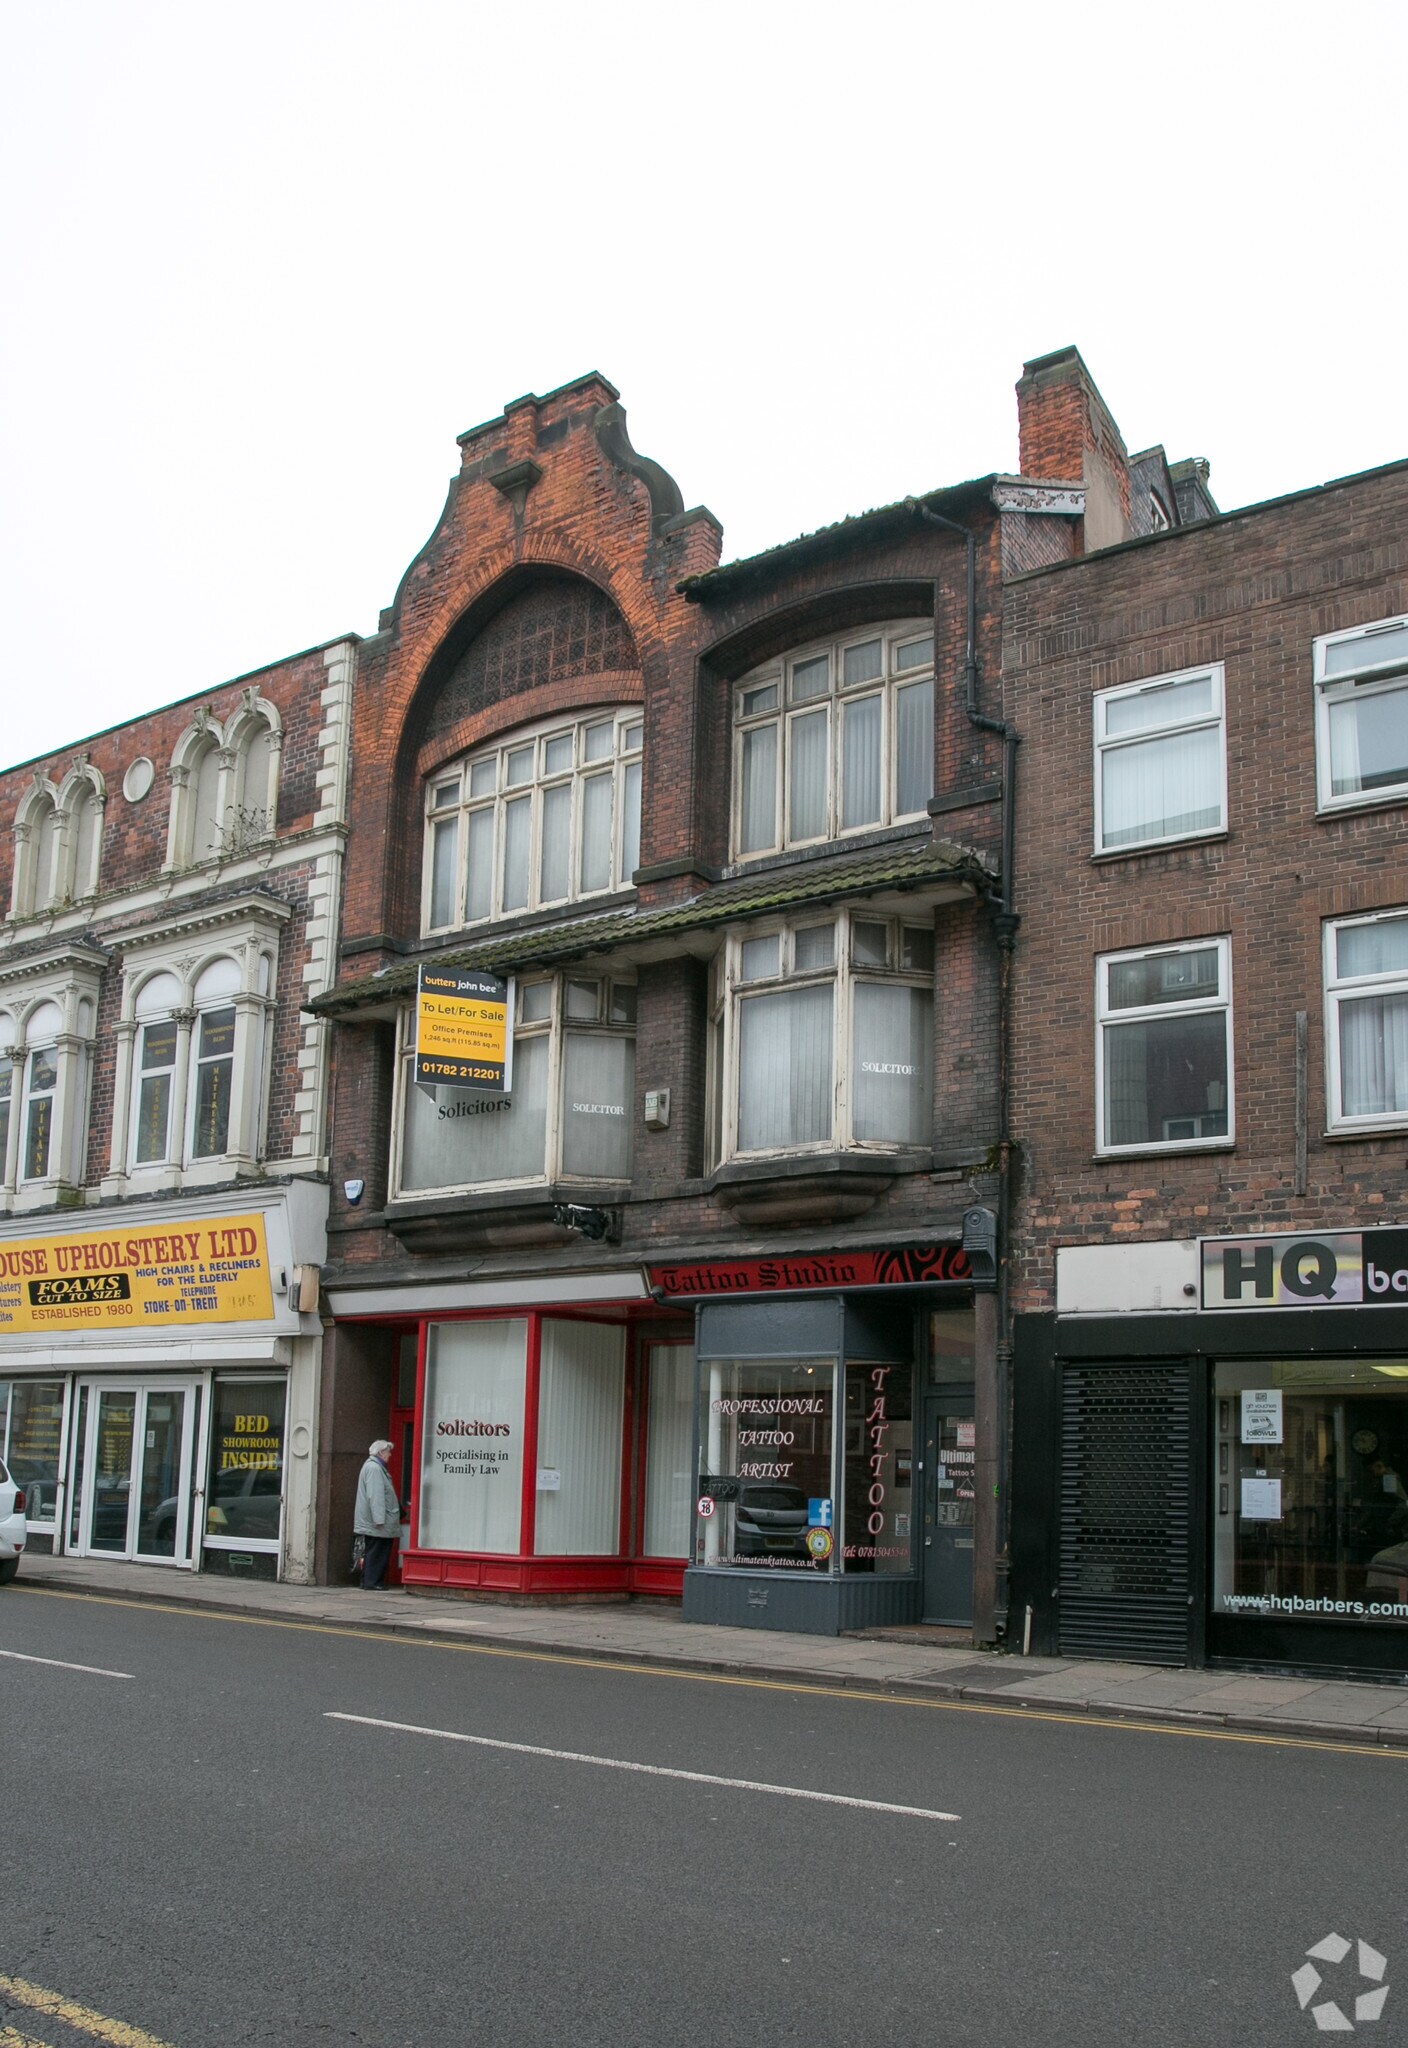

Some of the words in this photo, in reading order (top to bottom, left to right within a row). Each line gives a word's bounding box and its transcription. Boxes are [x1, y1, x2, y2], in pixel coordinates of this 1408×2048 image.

[425, 976, 457, 988] butters
[457, 980, 478, 991] john
[479, 983, 496, 993] bee
[422, 1002, 435, 1013] To
[438, 1004, 477, 1018] Let/For
[480, 1009, 504, 1021] Sale
[432, 1024, 456, 1034] Office
[457, 1027, 493, 1039] Premises
[422, 1062, 458, 1076] 01782
[459, 1066, 500, 1080] 212201
[438, 1096, 512, 1120] Solicitors
[35, 1101, 46, 1176] DIVANS
[54, 1233, 200, 1272] UPHOLSTERY
[208, 1227, 257, 1259] LTD
[136, 1268, 158, 1277] HIGH
[161, 1264, 195, 1275] CHAIRS
[199, 1263, 205, 1272] &
[209, 1258, 261, 1271] RECLINERS
[662, 1268, 749, 1293] Tattoo
[759, 1259, 856, 1287] Studio
[1223, 1241, 1337, 1300] HQ
[37, 1276, 119, 1296] FOAMS
[157, 1278, 174, 1286] FOR
[178, 1275, 195, 1284] THE
[199, 1272, 238, 1283] ELDERLY
[38, 1295, 64, 1304] CUT
[69, 1292, 87, 1301] TO
[92, 1290, 122, 1300] SIZE
[181, 1286, 216, 1297] TELEPHONE
[31, 1306, 102, 1320] ESTABLISHED
[106, 1304, 133, 1315] 1980
[143, 1297, 218, 1314] STOKE-ON-TRENT
[712, 1399, 824, 1415] PROFESSIONAL
[234, 1415, 269, 1433] BED
[436, 1419, 511, 1437] Solicitors
[222, 1437, 279, 1449] SHOWROOM
[738, 1430, 794, 1446] TATTOO
[436, 1450, 496, 1462] Specialising
[498, 1450, 509, 1461] in
[866, 1367, 890, 1534] TATTOO
[222, 1451, 279, 1471] INSIDE
[443, 1464, 478, 1477] Family
[480, 1465, 500, 1475] Law
[736, 1462, 793, 1478] ARTIST
[960, 1490, 975, 1498] OPEN
[702, 1504, 710, 1514] 18
[842, 1545, 856, 1558] Tel:
